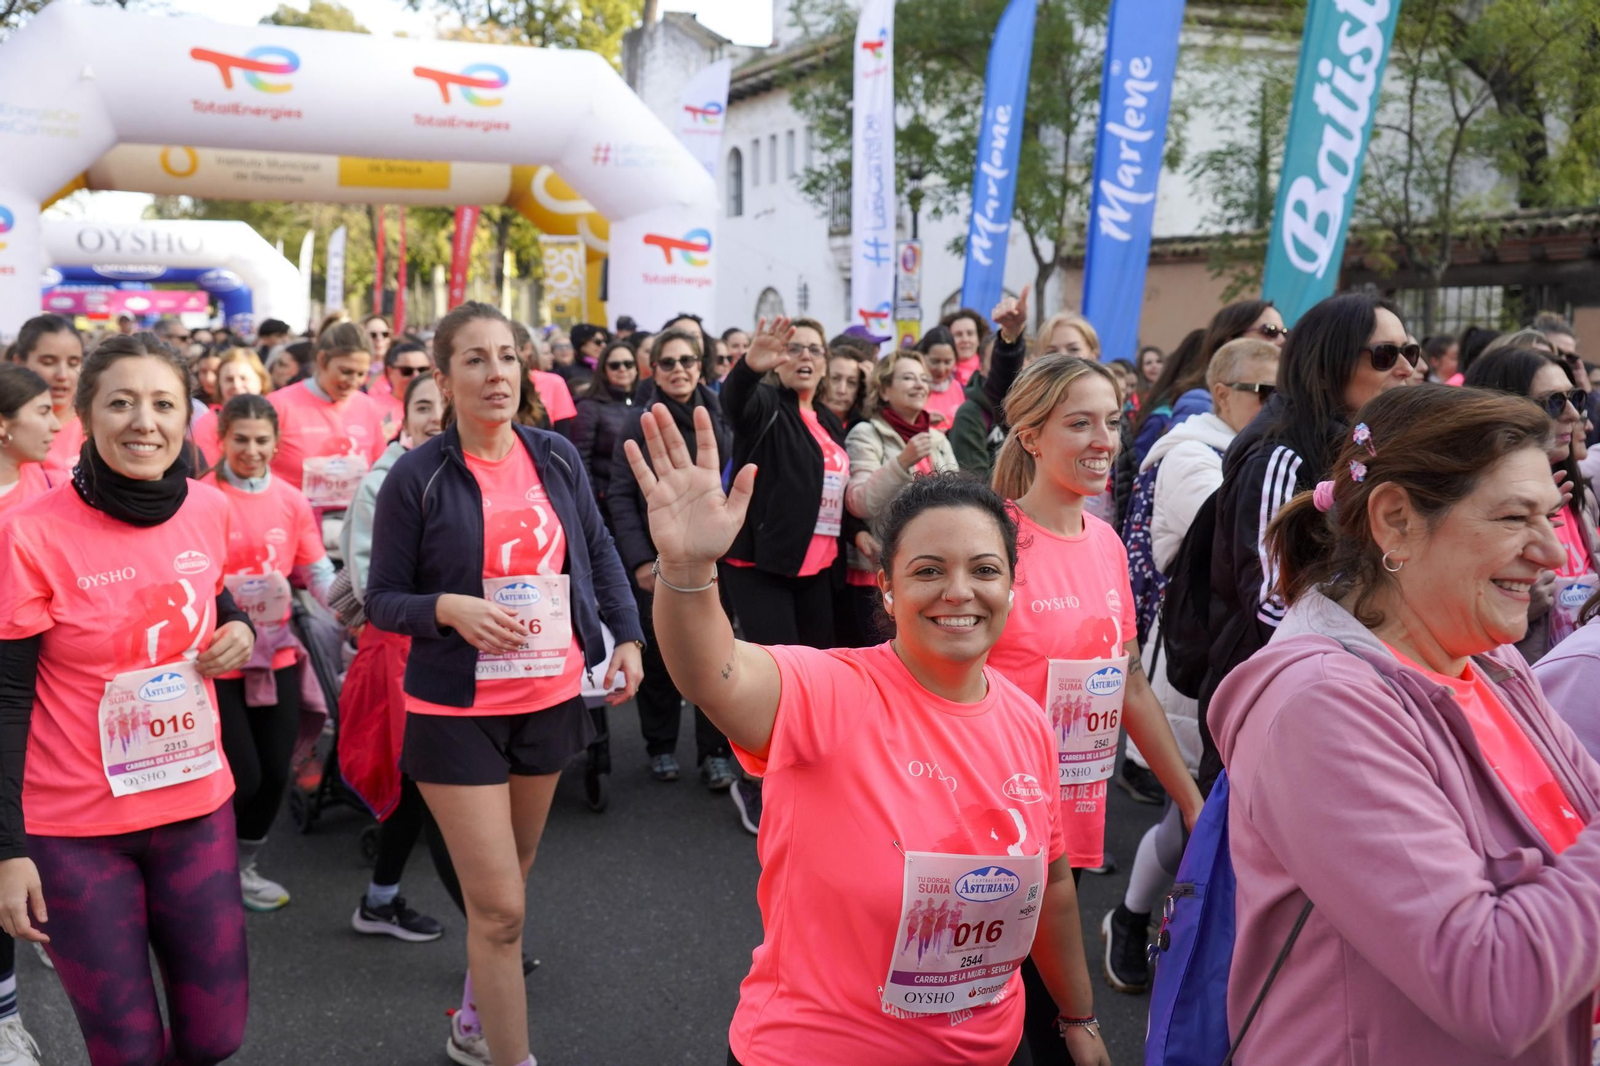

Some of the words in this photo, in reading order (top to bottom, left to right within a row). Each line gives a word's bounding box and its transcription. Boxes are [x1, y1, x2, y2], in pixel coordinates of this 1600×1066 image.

[191, 100, 303, 120] TotalEnergies
[413, 114, 511, 132] TotalEnergies
[1097, 56, 1159, 242] Marlene
[971, 104, 1012, 267] Marlene
[77, 227, 204, 254] OYSHO
[77, 566, 136, 590] OYSHO
[1031, 596, 1080, 613] OYSHO
[475, 664, 511, 674] OYSHO
[1058, 683, 1083, 691] SUMA
[150, 711, 195, 737] 016
[1087, 709, 1118, 732] 016
[164, 740, 188, 752] 2313
[1094, 738, 1109, 749] 2543
[1061, 753, 1086, 762] CARRERA
[124, 770, 167, 787] OYSHO
[1077, 784, 1090, 799] DE
[1092, 783, 1103, 799] LA
[1075, 801, 1097, 813] 2025
[918, 883, 951, 894] SUMA
[959, 879, 1015, 894] ASTURIANA
[953, 919, 1005, 947] 016
[960, 954, 983, 968] 2544
[914, 974, 948, 983] CARRERA
[949, 973, 958, 982] DE
[958, 972, 966, 980] LA
[967, 968, 987, 979] MUJER
[991, 963, 1013, 974] SEVILLA
[904, 991, 955, 1004] OYSHO
[948, 1007, 974, 1026] 2025
